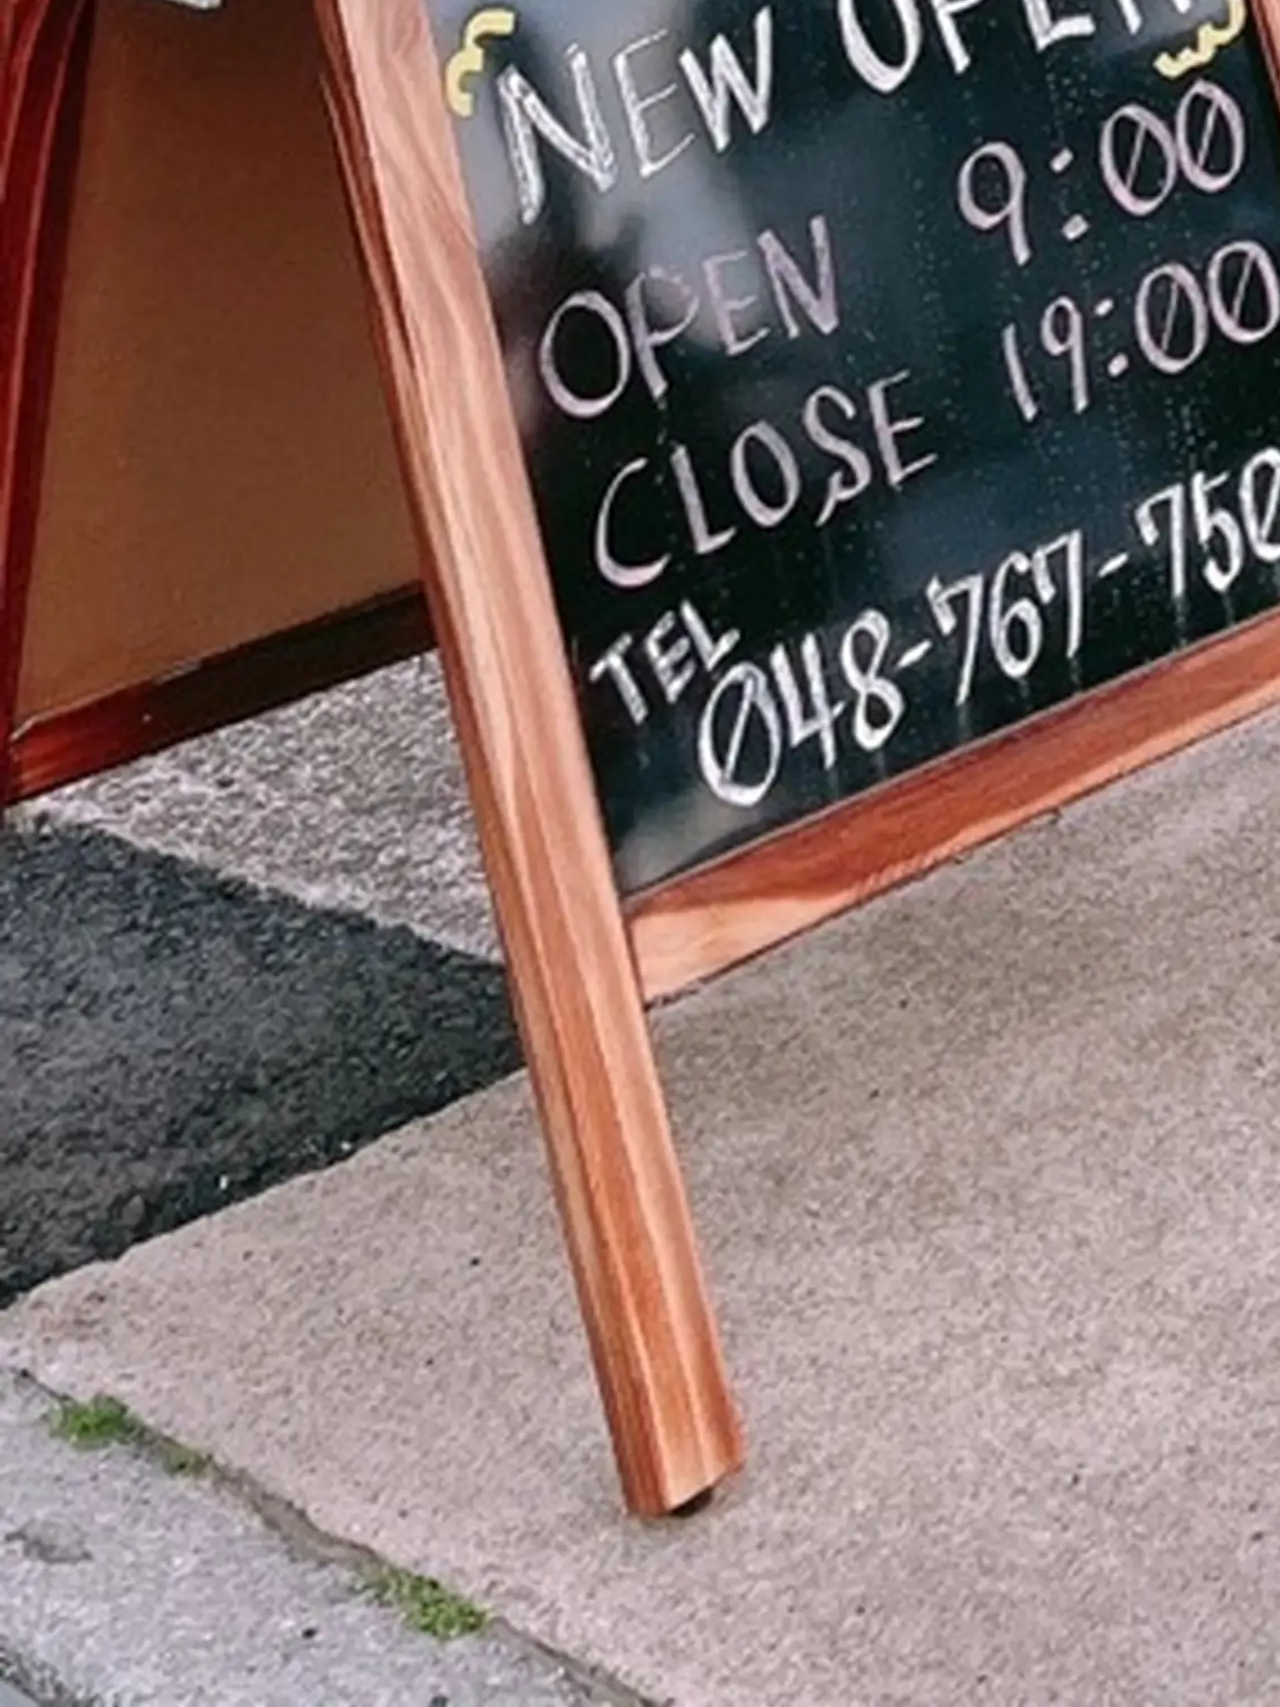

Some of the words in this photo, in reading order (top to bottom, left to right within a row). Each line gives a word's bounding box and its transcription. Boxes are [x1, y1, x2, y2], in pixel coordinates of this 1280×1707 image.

[493, 6, 774, 223] NEW
[537, 214, 840, 419] OPEN
[957, 78, 1246, 266] 9:00
[594, 369, 938, 589] CLOSE
[589, 599, 740, 726] TEL
